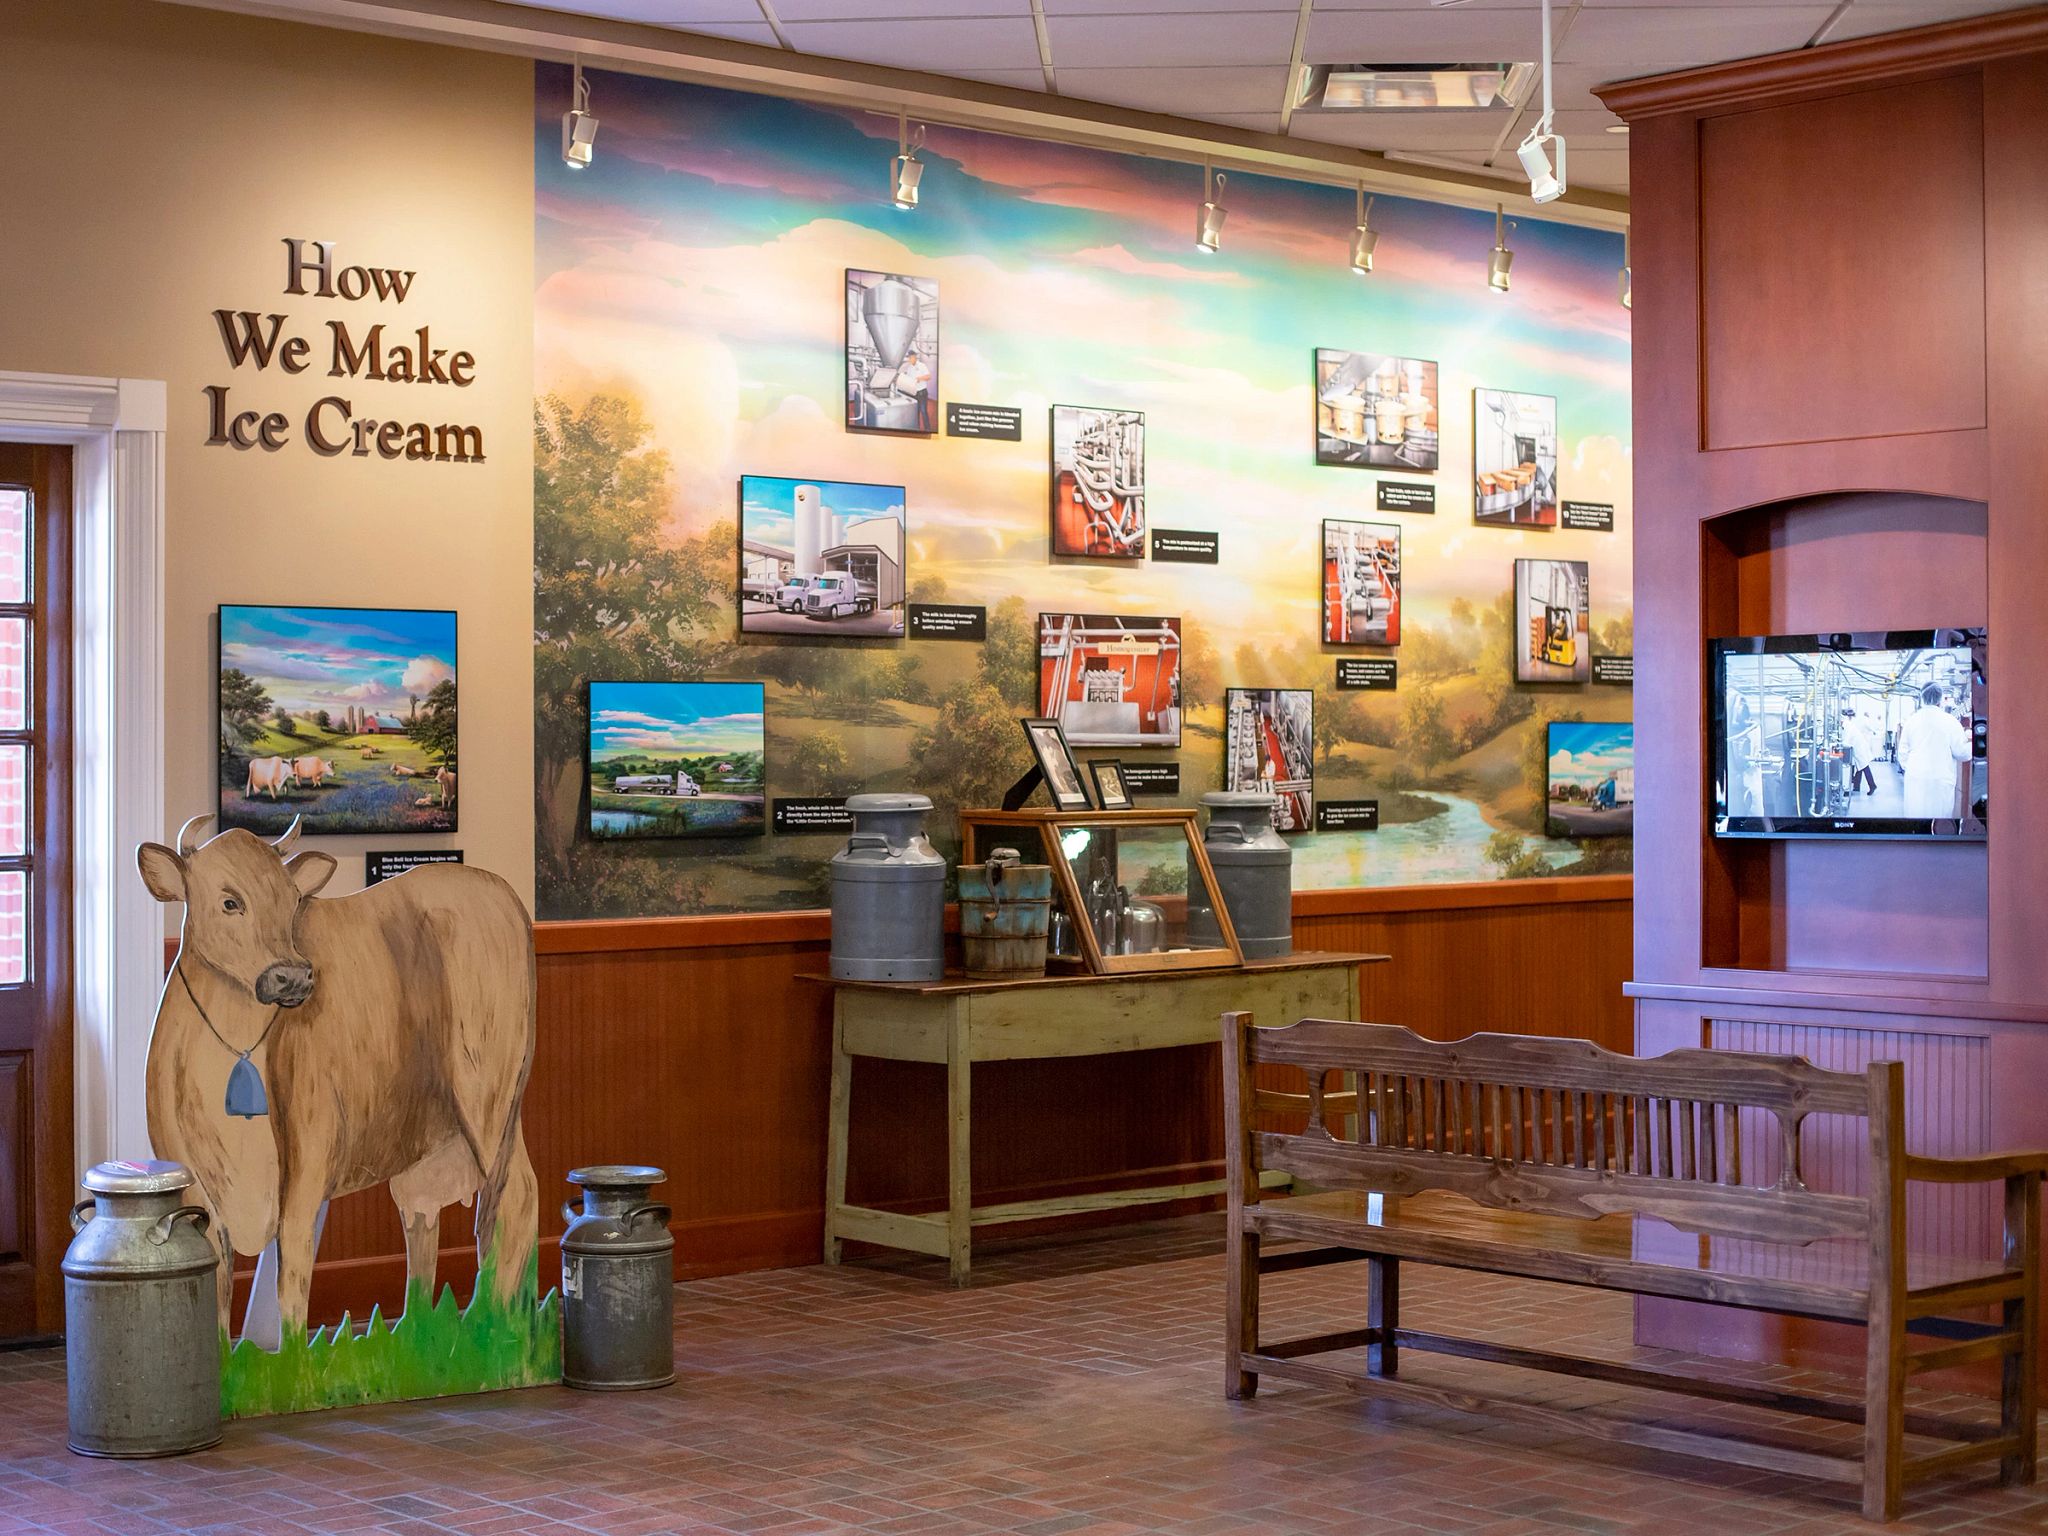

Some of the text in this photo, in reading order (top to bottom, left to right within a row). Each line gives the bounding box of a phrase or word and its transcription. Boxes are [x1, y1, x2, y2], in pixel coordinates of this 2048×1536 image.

[281, 237, 416, 304] How
[211, 309, 475, 387] We Make
[950, 415, 955, 423] 4
[202, 385, 487, 464] Ice Cream
[777, 811, 782, 819] 2
[1320, 812, 1324, 820] 7
[372, 866, 376, 875] 1
